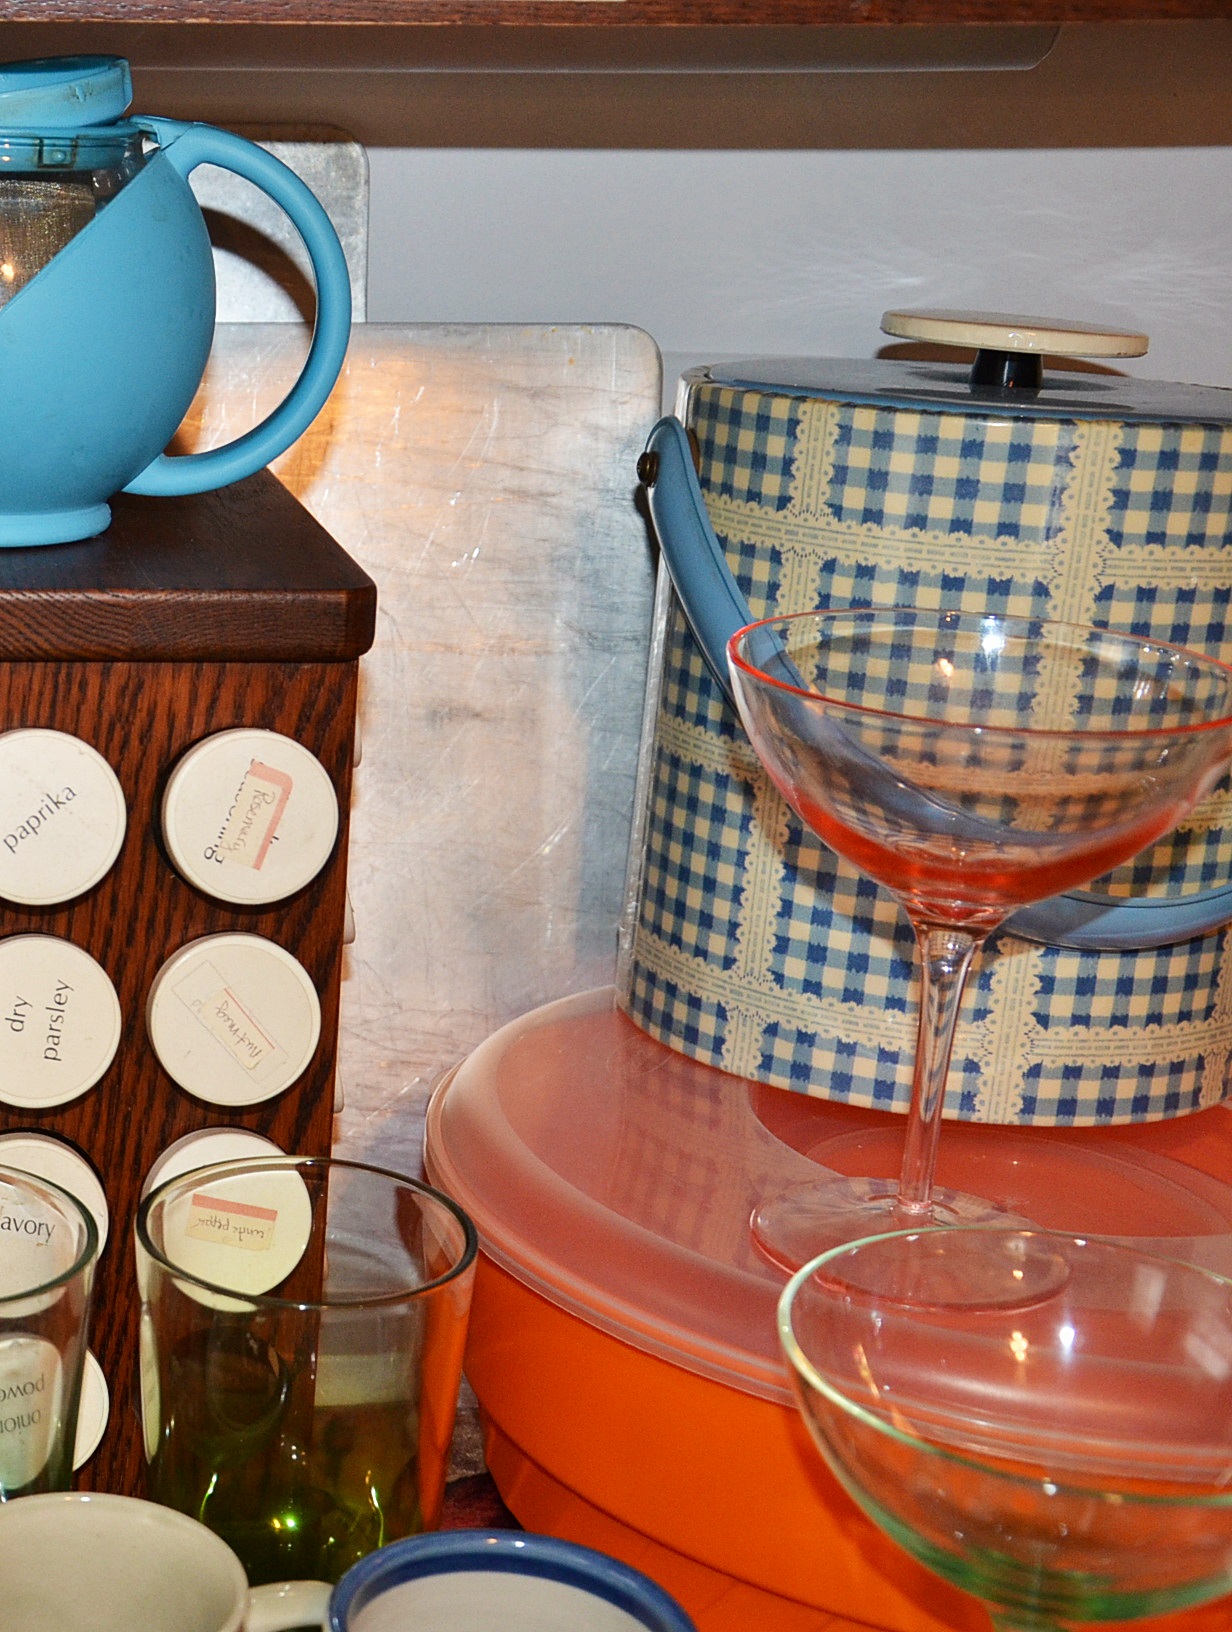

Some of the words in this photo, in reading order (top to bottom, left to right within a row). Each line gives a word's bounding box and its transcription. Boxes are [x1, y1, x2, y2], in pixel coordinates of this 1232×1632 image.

[2, 784, 77, 854] paprika
[219, 788, 276, 852] Rosemary
[4, 994, 33, 1034] dry
[43, 978, 75, 1063] parsley
